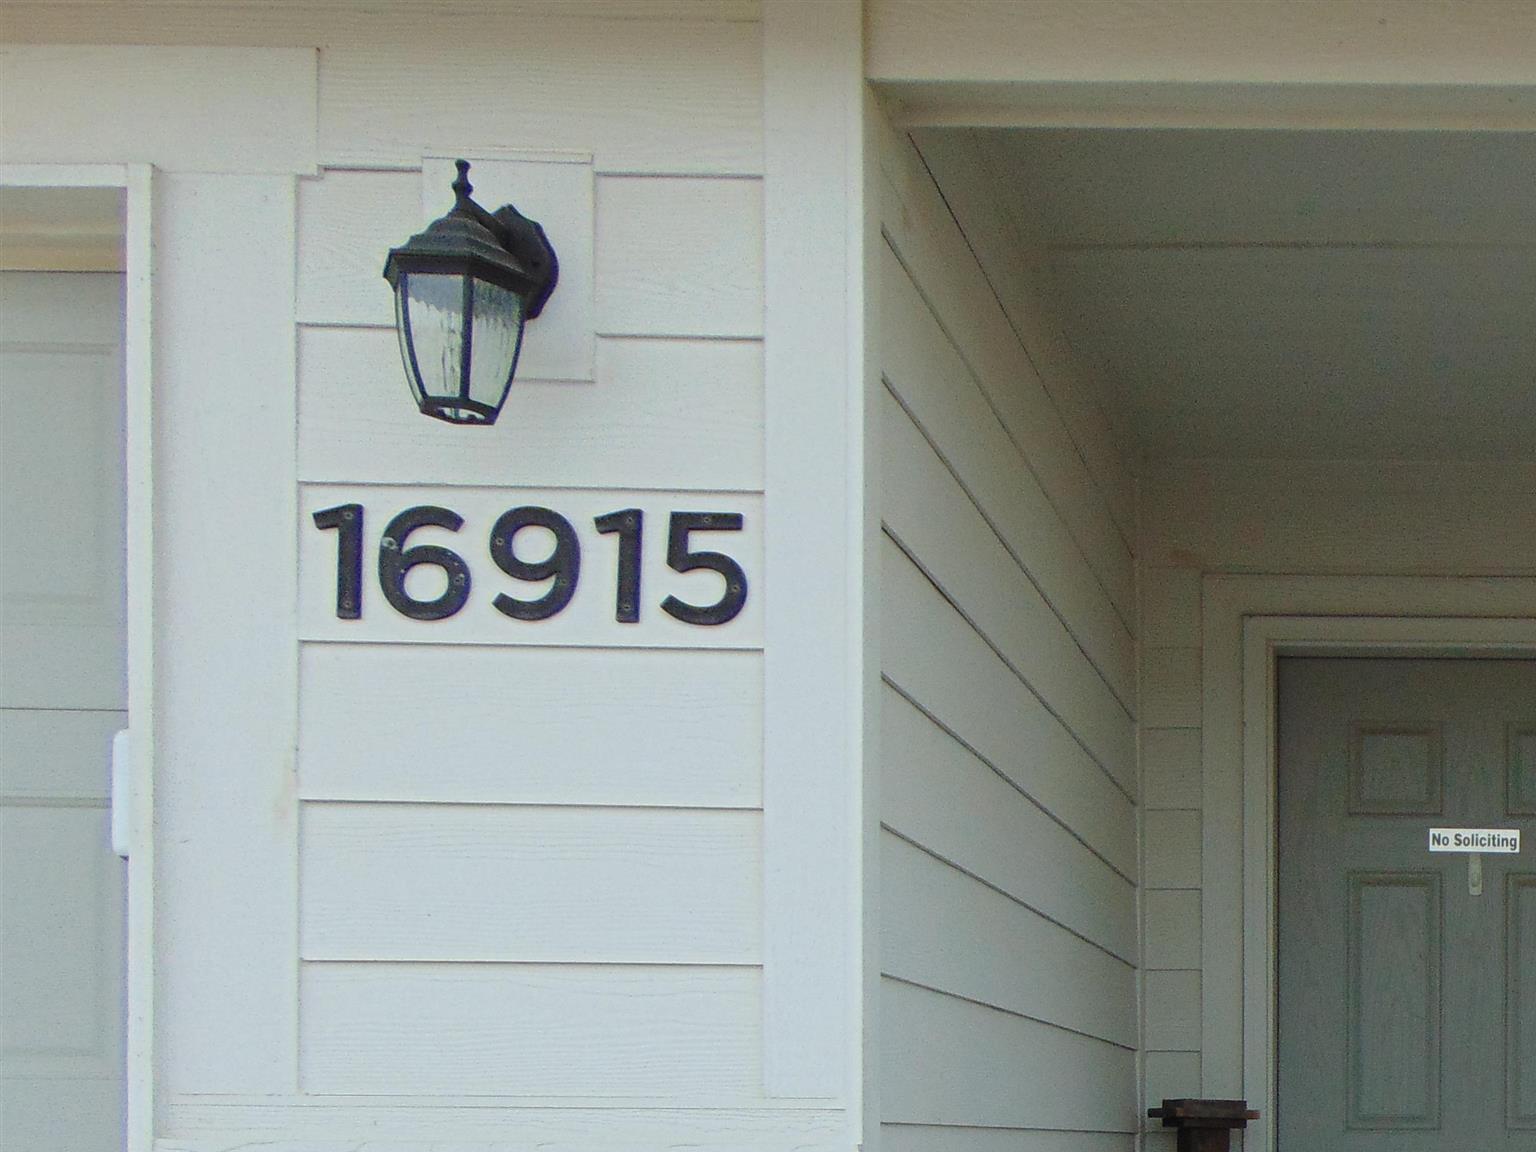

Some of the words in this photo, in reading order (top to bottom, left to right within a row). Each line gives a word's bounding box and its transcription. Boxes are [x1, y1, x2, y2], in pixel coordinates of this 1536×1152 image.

[312, 503, 748, 626] 16915
[1431, 833, 1449, 846] No
[1454, 833, 1517, 850] Soliciting
